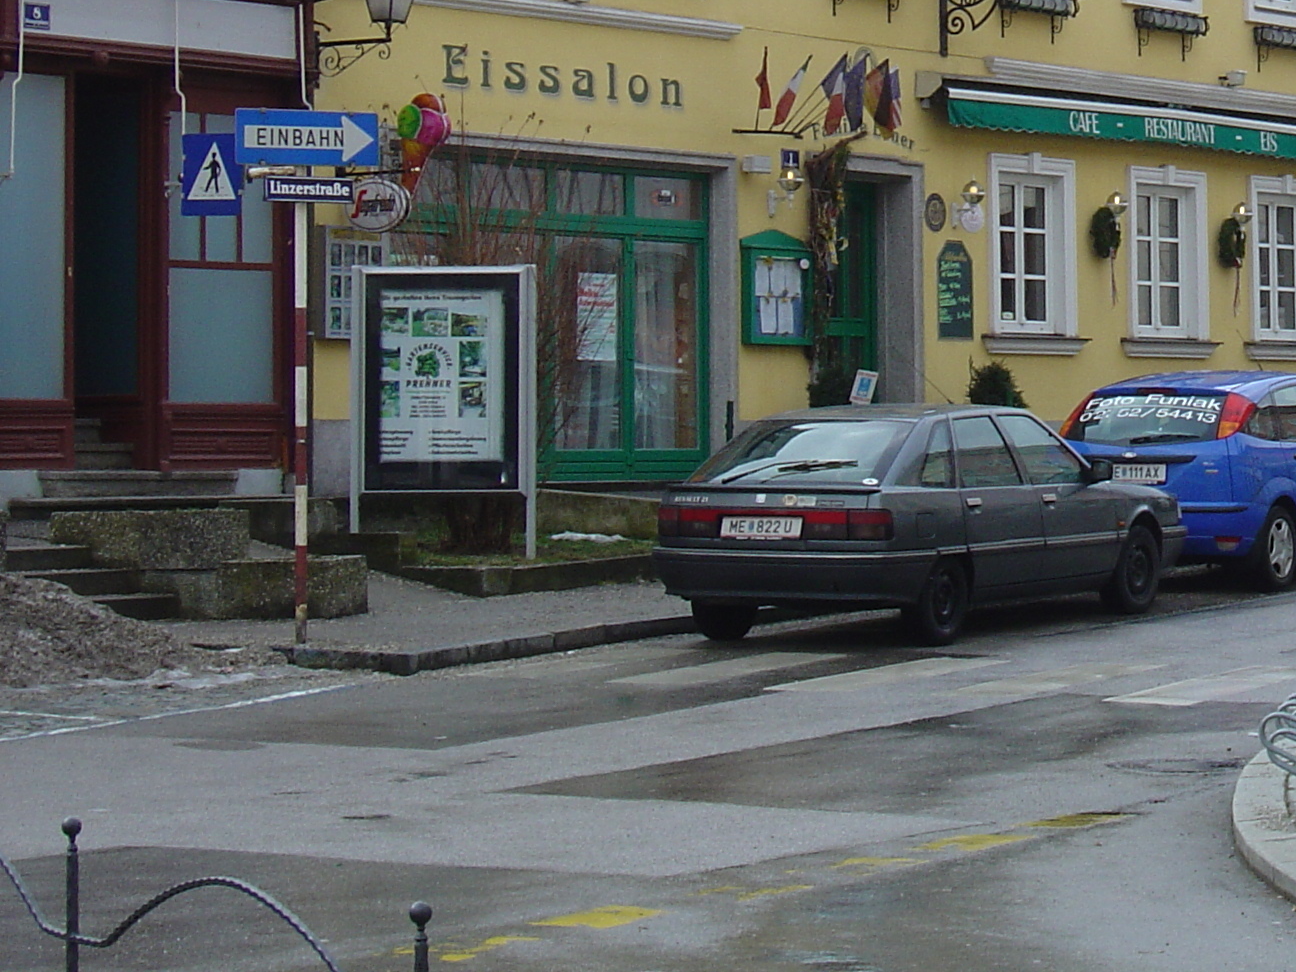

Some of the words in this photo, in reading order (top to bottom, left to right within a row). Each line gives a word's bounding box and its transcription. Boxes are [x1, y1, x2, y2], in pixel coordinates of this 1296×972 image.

[442, 44, 682, 106] Eissalon
[257, 127, 344, 146] EINBAHN
[1144, 117, 1215, 144] RESTAURANT
[1260, 131, 1278, 152] EIS
[270, 180, 350, 196] Linzerstraße
[1086, 396, 1135, 410] Foto
[729, 520, 748, 533] ME
[756, 520, 782, 533] 822
[784, 520, 793, 533] U
